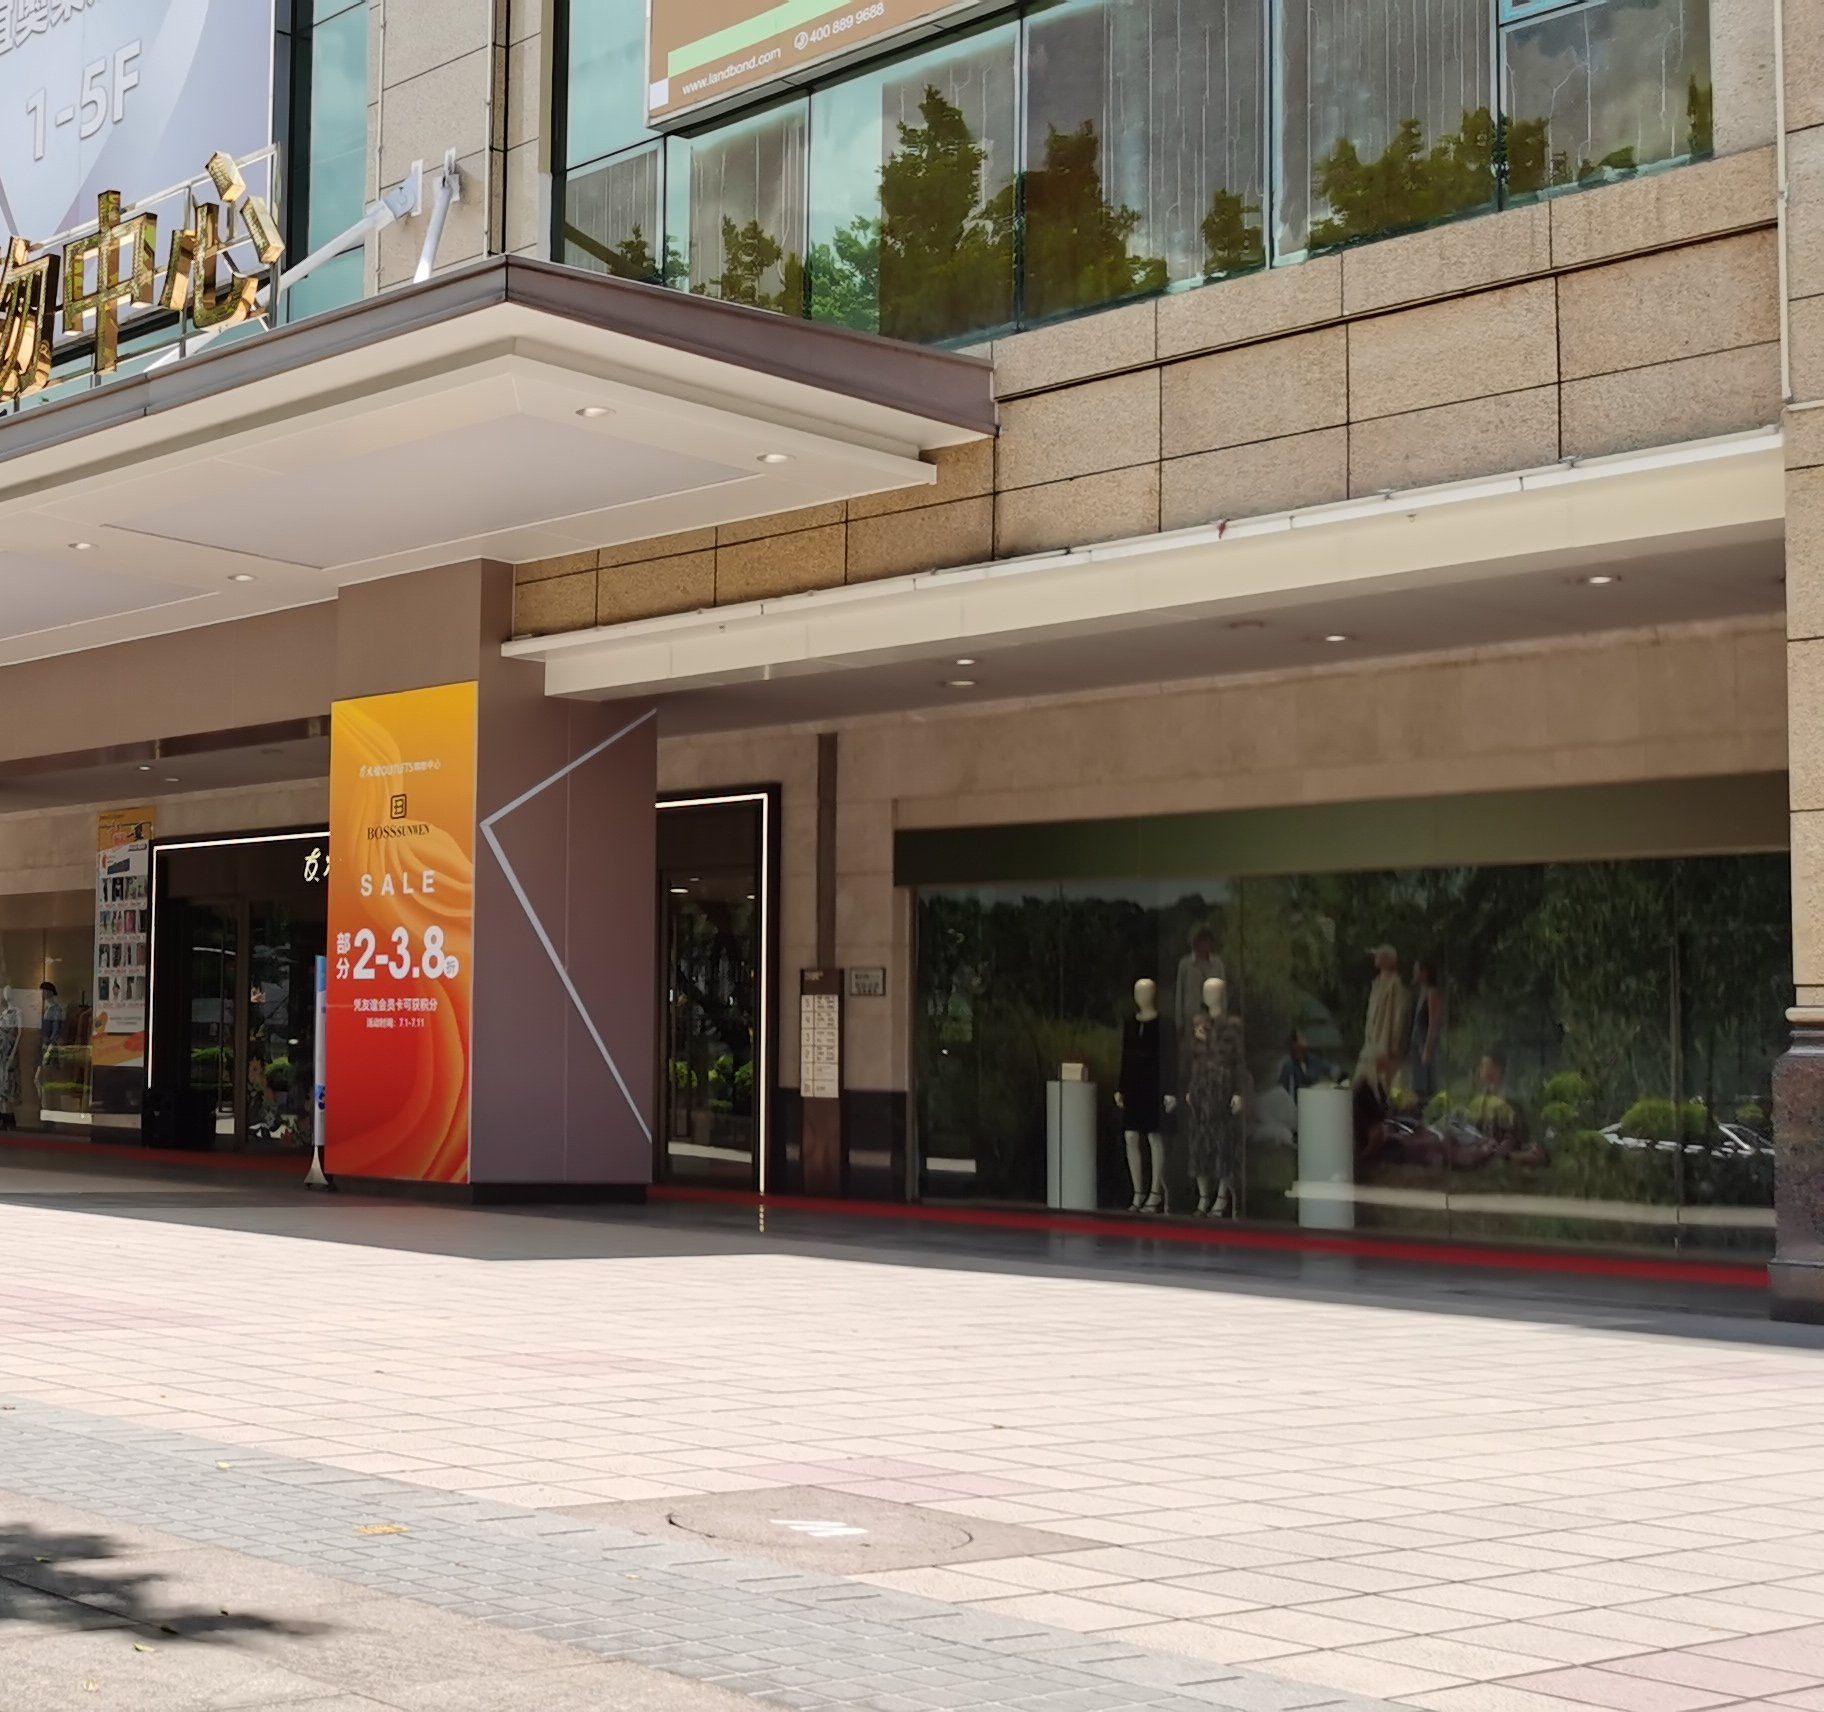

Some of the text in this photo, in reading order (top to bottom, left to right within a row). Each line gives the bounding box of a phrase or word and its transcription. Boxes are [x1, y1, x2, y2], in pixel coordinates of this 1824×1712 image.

[809, 3, 885, 43] 400 889 9688
[681, 47, 782, 95] www.landbond.com
[27, 38, 142, 162] 1-5F
[360, 869, 436, 897] SALE
